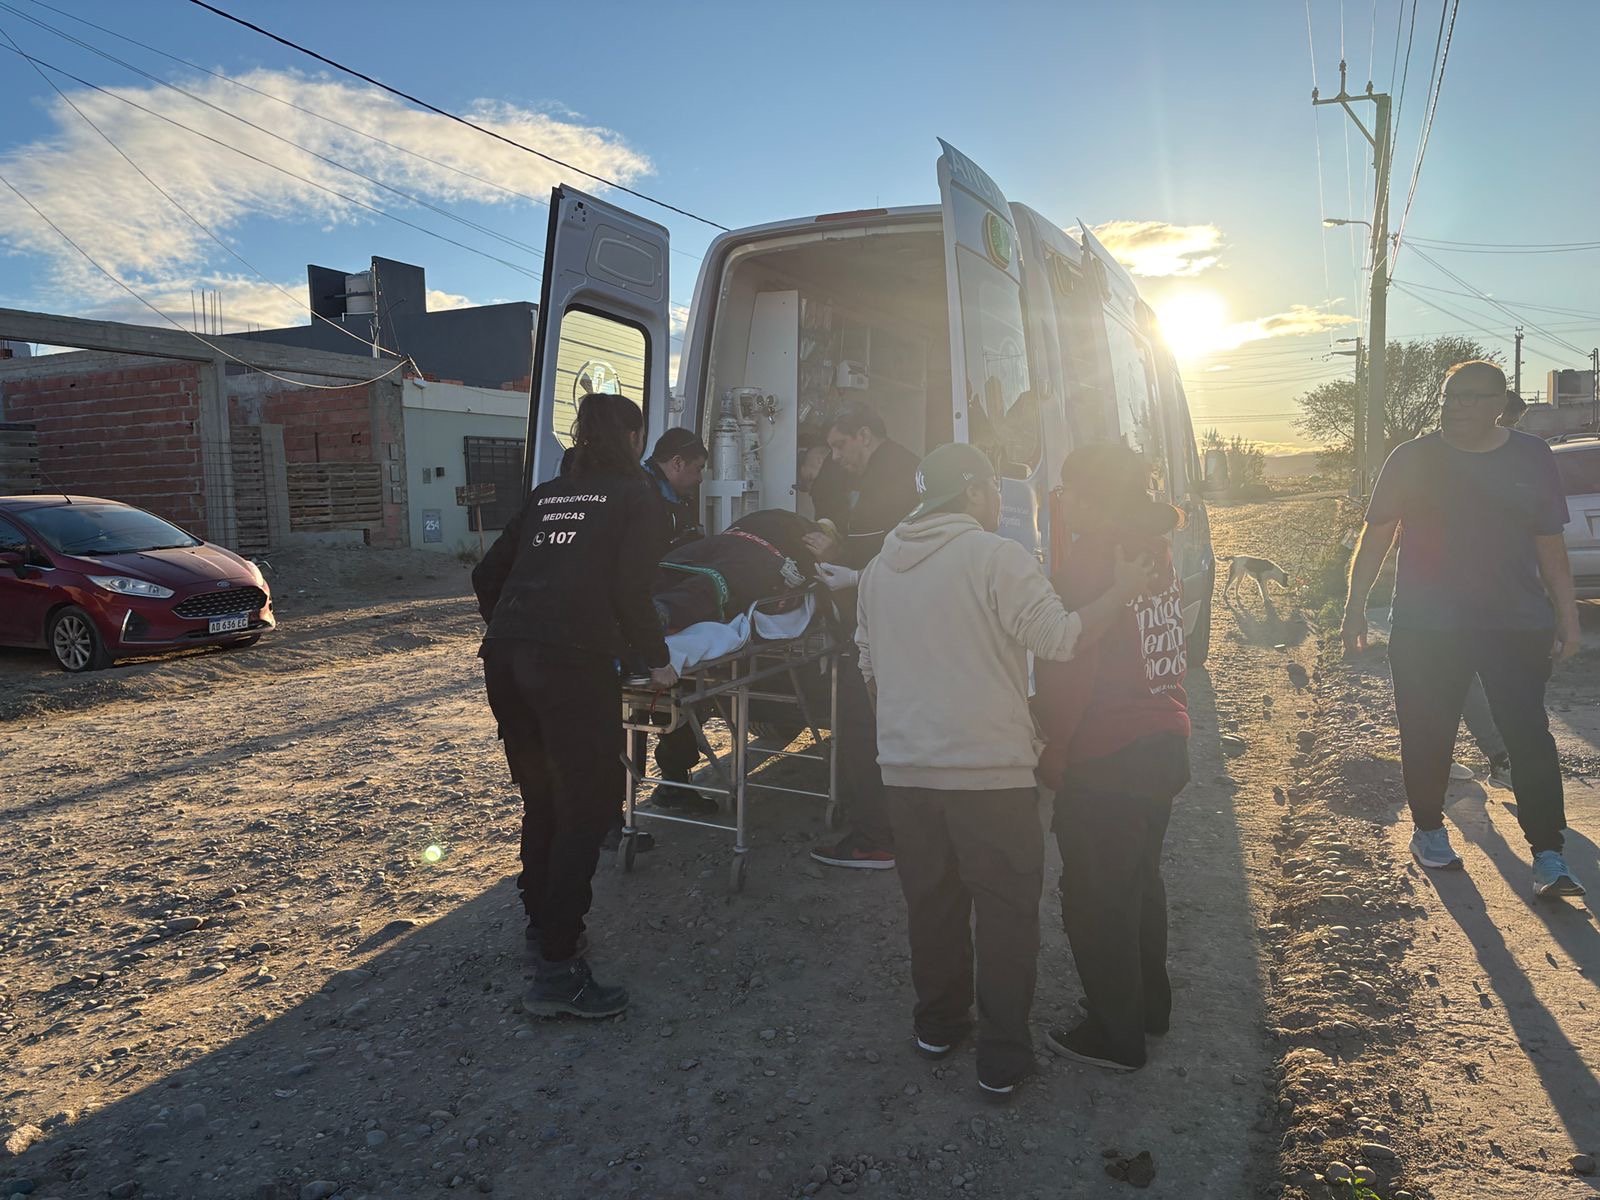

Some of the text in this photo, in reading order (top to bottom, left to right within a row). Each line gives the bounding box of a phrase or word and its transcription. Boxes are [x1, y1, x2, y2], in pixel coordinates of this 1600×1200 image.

[537, 494, 607, 506] EMERGENCIAS
[542, 512, 585, 522] MEDICAS
[548, 531, 577, 544] 107
